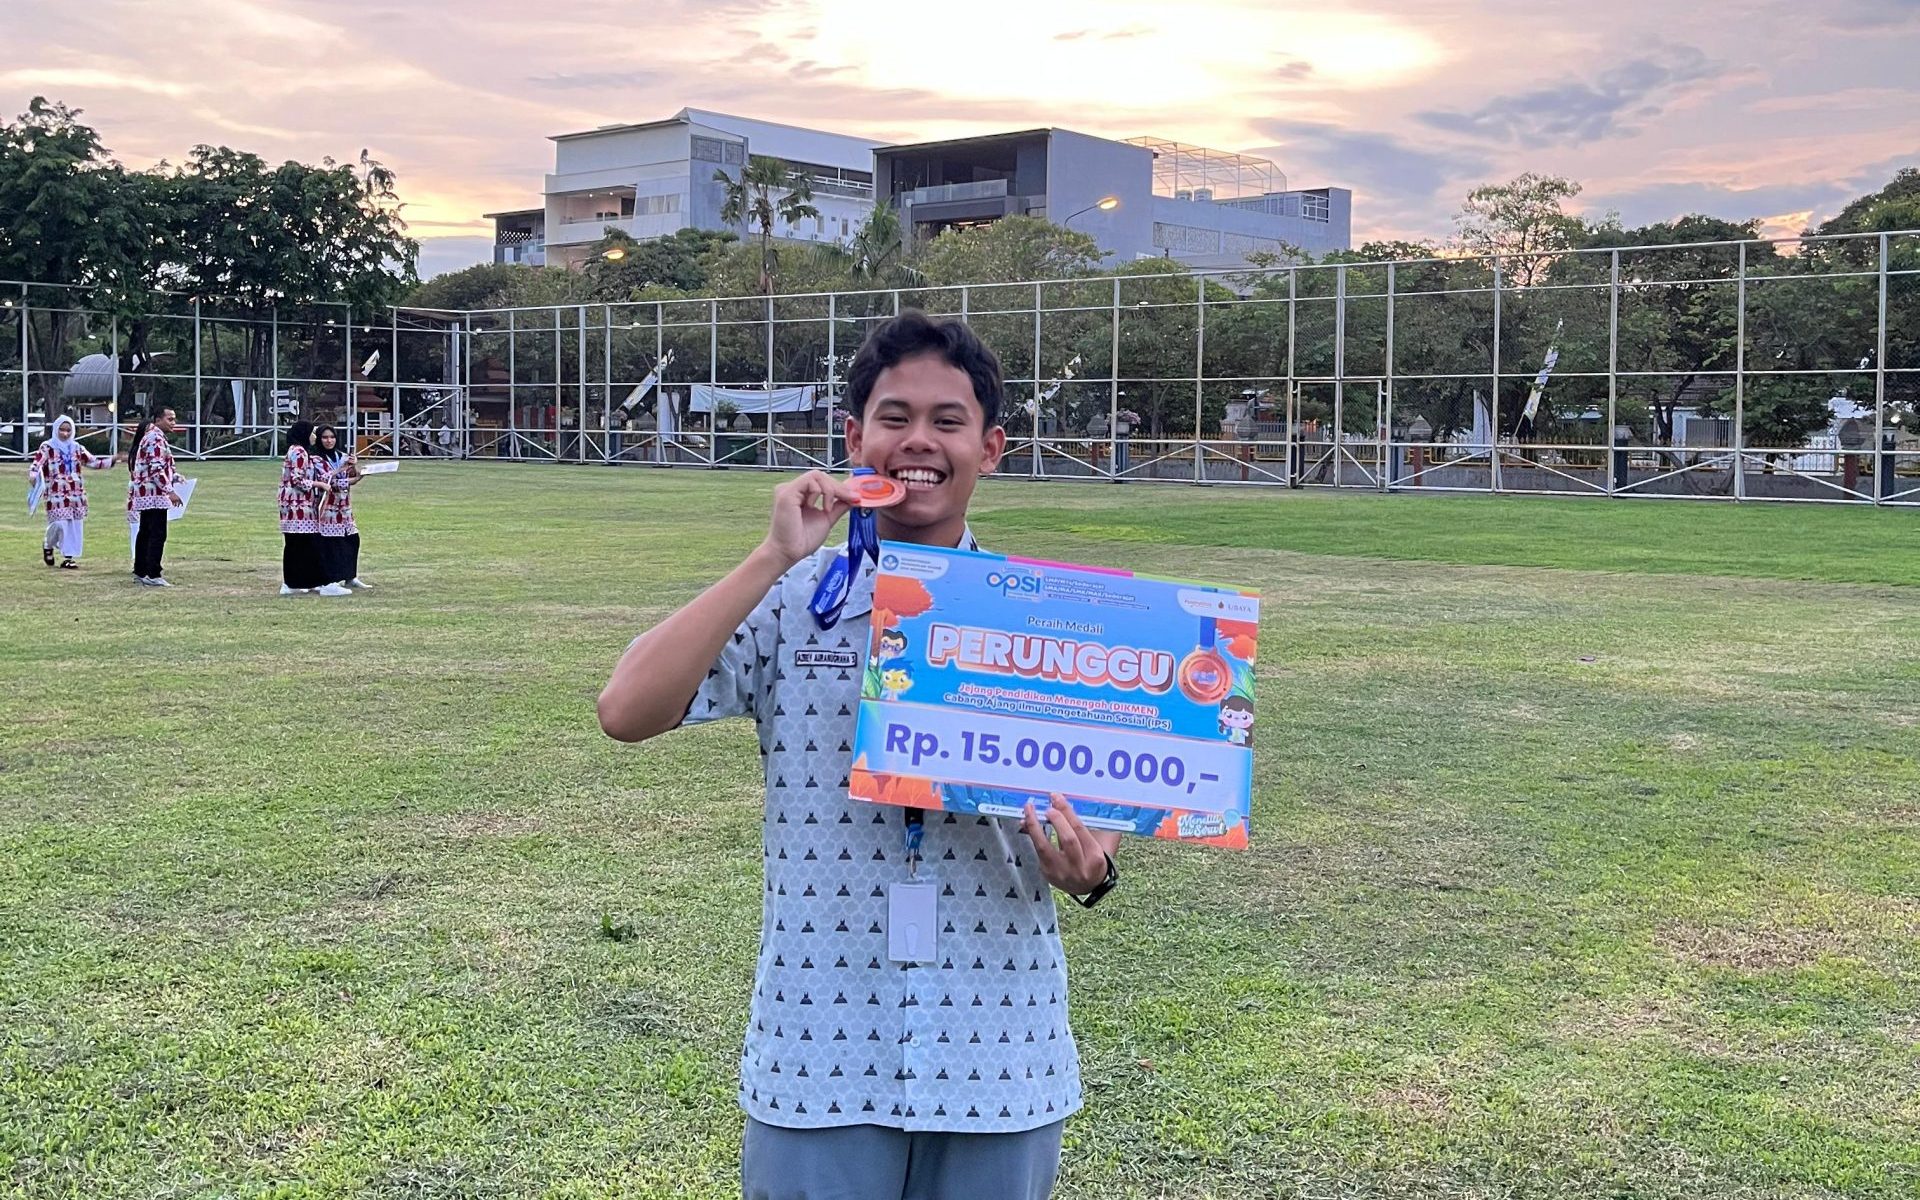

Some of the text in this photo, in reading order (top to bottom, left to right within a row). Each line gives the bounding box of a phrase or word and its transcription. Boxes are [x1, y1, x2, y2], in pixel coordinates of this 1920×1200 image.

[1027, 616, 1103, 635] Peraih Medali
[929, 624, 1174, 693] PERUNGGU
[944, 693, 984, 706] Cabang
[986, 699, 1016, 710] Ajang
[1044, 705, 1113, 722] Pengetahuan
[1115, 714, 1146, 726] Sosial
[959, 683, 1158, 717] Jejang Pendidikan Menengah (DIKMEN)
[885, 723, 1219, 794] Rp. 15.000.000,-
